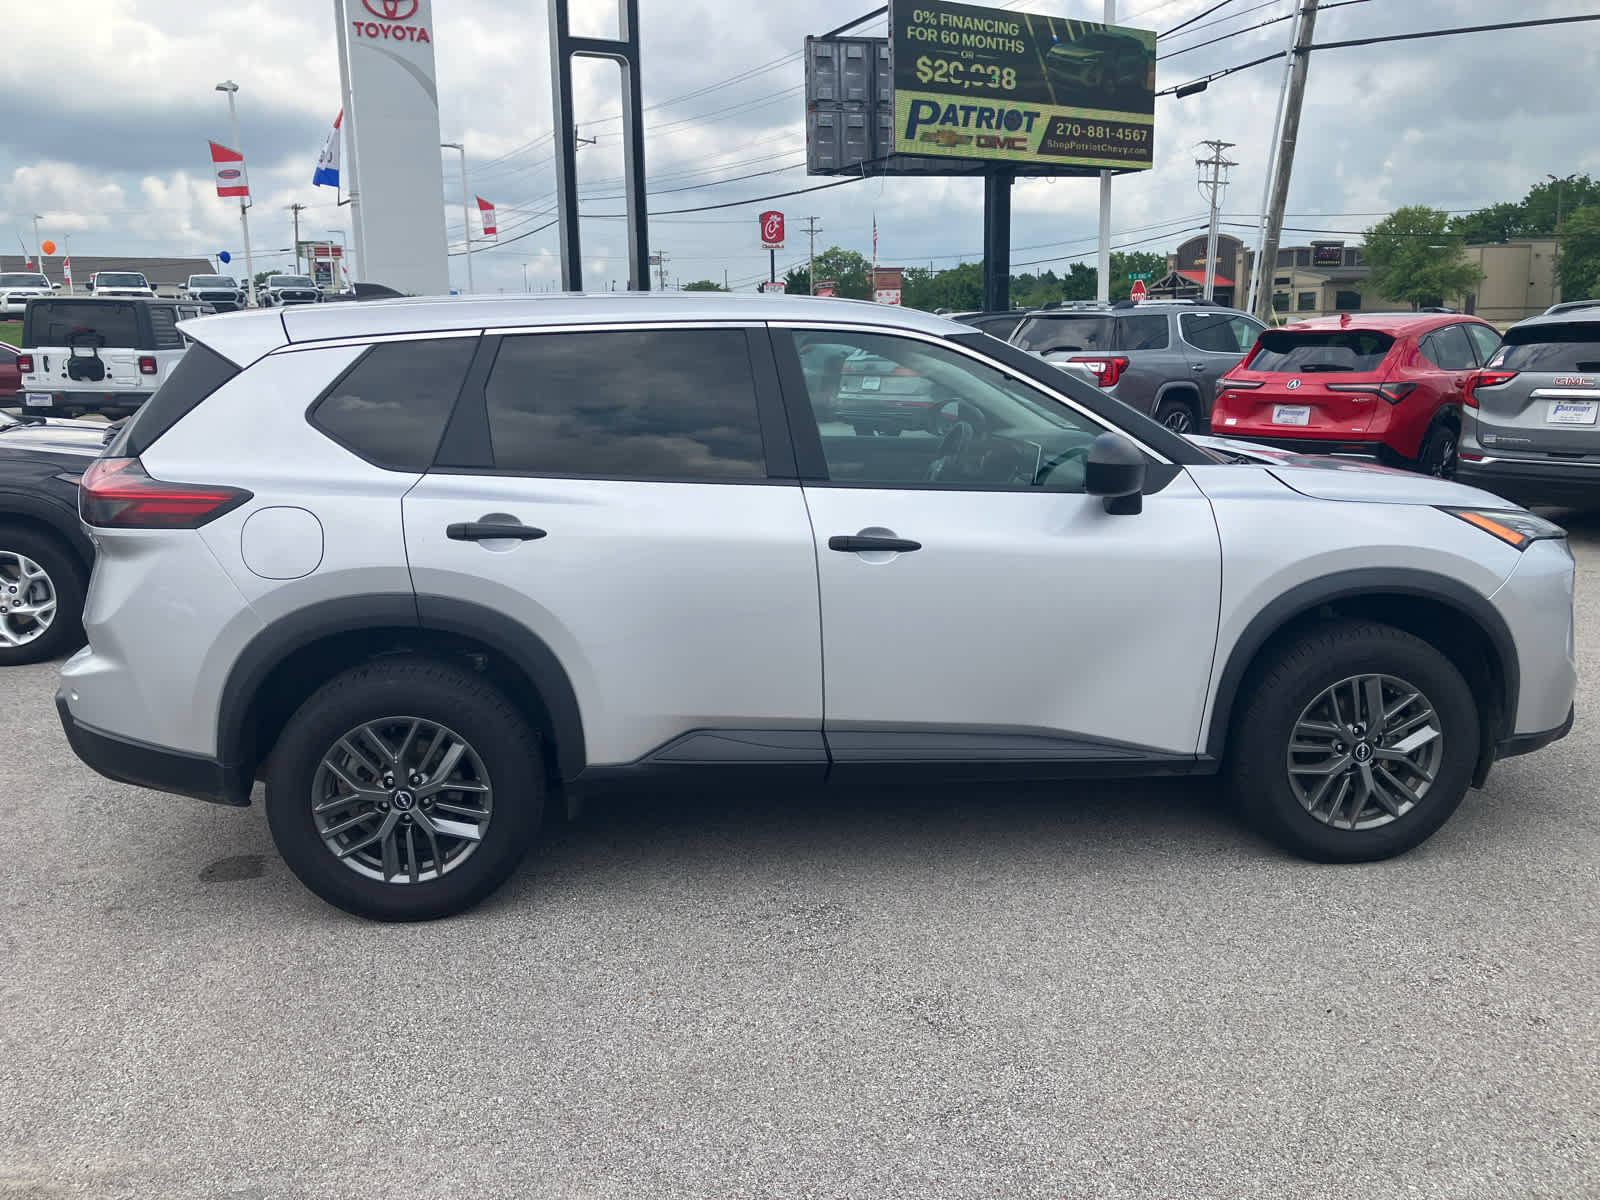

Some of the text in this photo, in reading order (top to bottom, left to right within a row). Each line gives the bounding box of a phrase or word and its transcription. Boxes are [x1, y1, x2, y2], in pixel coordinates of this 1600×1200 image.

[352, 21, 430, 43] TOYOTA
[913, 9, 1019, 36] 0% FINANCING
[907, 26, 1025, 54] FOR 60 MONTHS
[960, 50, 974, 60] OR
[905, 99, 1040, 140] PATRIOT
[1056, 122, 1147, 142] 270-881-4567
[1553, 376, 1594, 386] GMC
